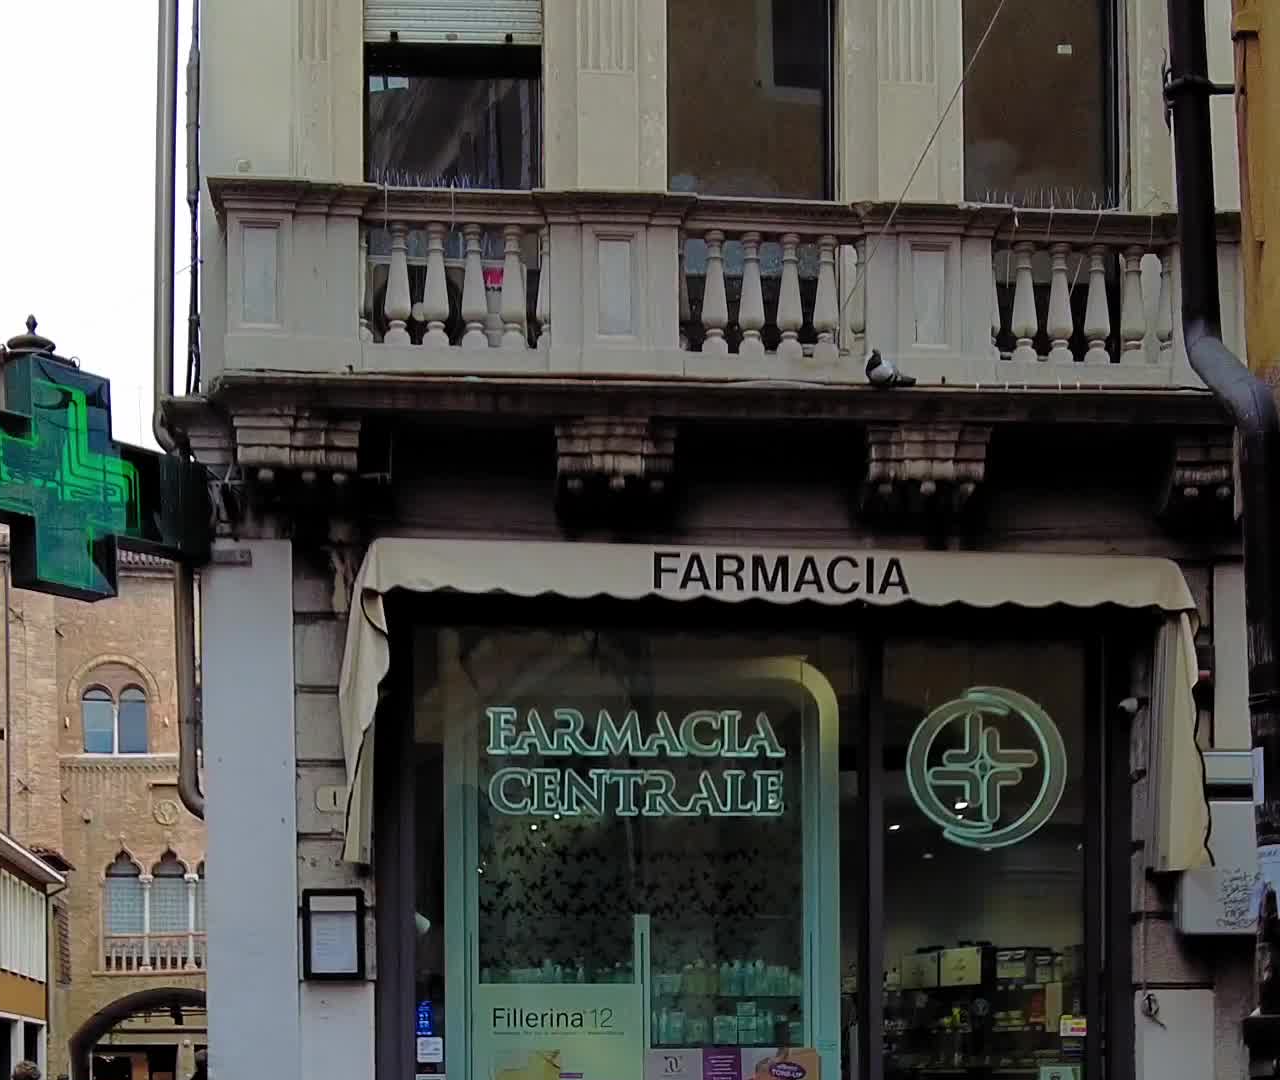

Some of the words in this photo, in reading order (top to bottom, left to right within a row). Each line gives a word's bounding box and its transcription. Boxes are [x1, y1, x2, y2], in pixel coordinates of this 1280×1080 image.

[653, 551, 910, 596] FARMACIA
[486, 706, 786, 757] FARMACIA
[487, 766, 785, 817] CENTRALE
[493, 1007, 584, 1029] Fillerina
[592, 1007, 613, 1028] 12
